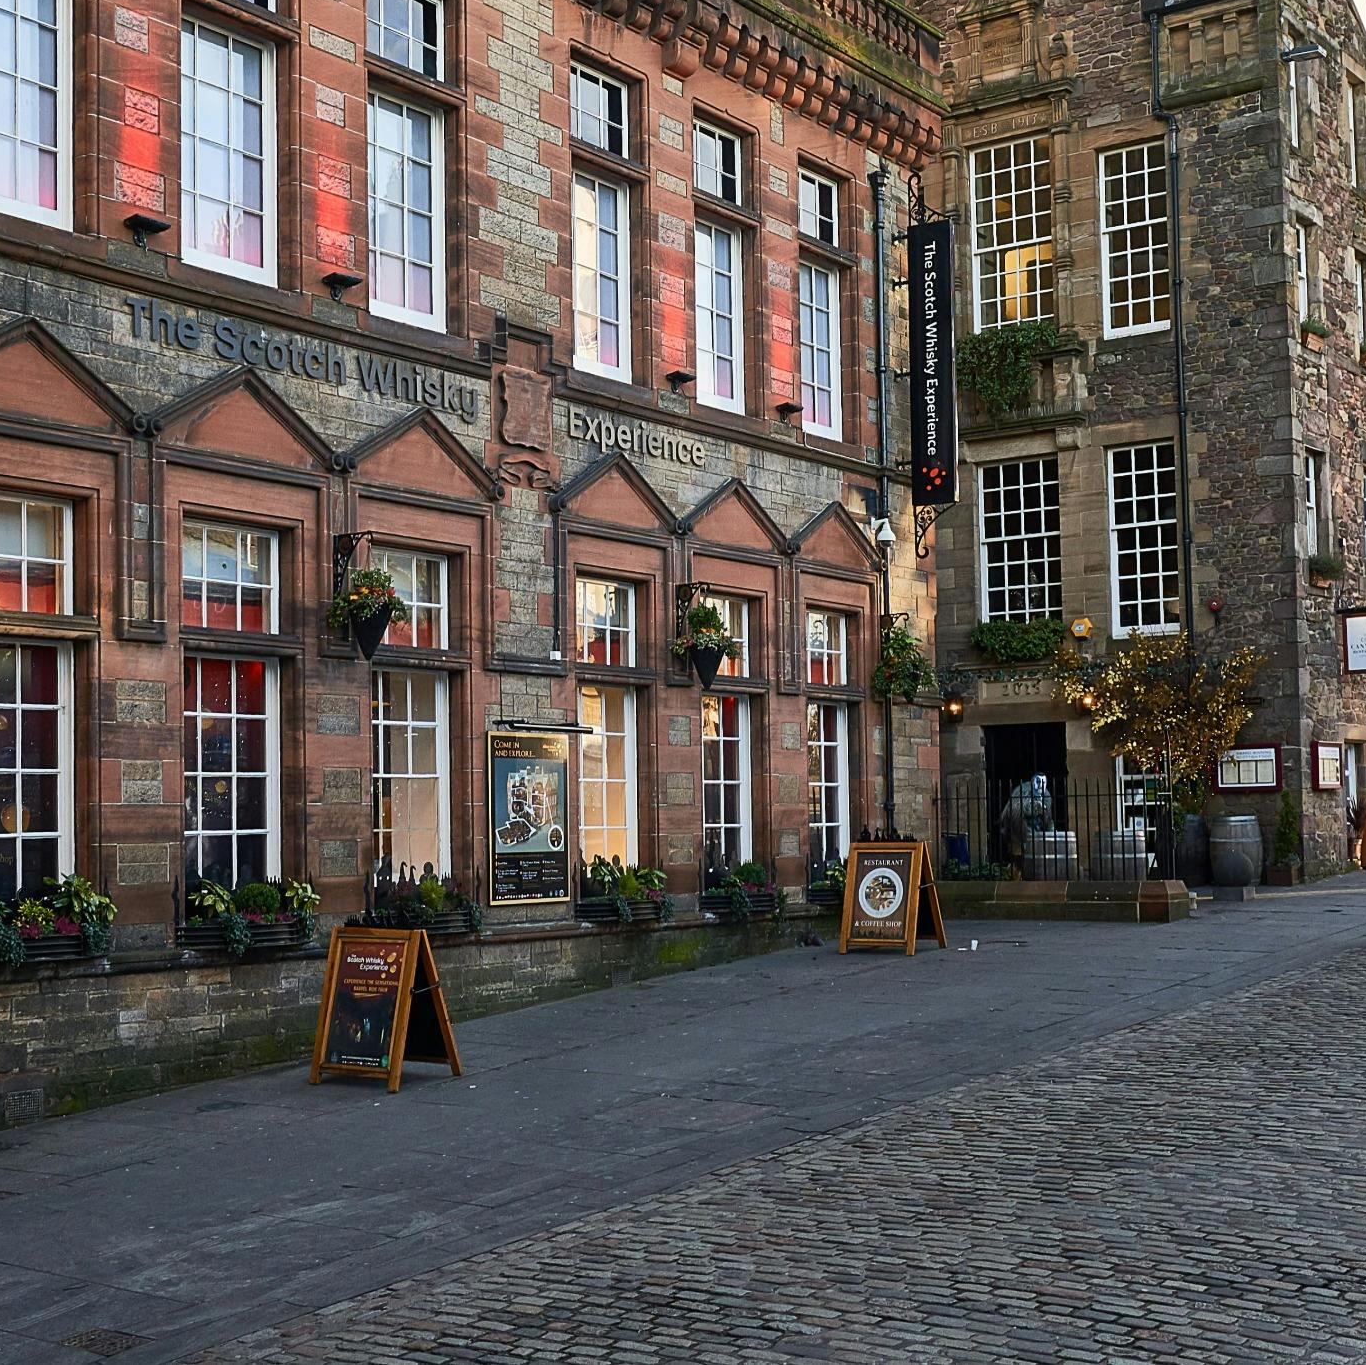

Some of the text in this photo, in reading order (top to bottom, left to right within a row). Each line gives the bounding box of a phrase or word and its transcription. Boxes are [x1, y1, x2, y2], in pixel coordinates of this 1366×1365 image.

[126, 298, 479, 424] The Scotch Whisky
[924, 240, 939, 456] The Scotch Whisky Experience
[569, 404, 706, 467] Experience
